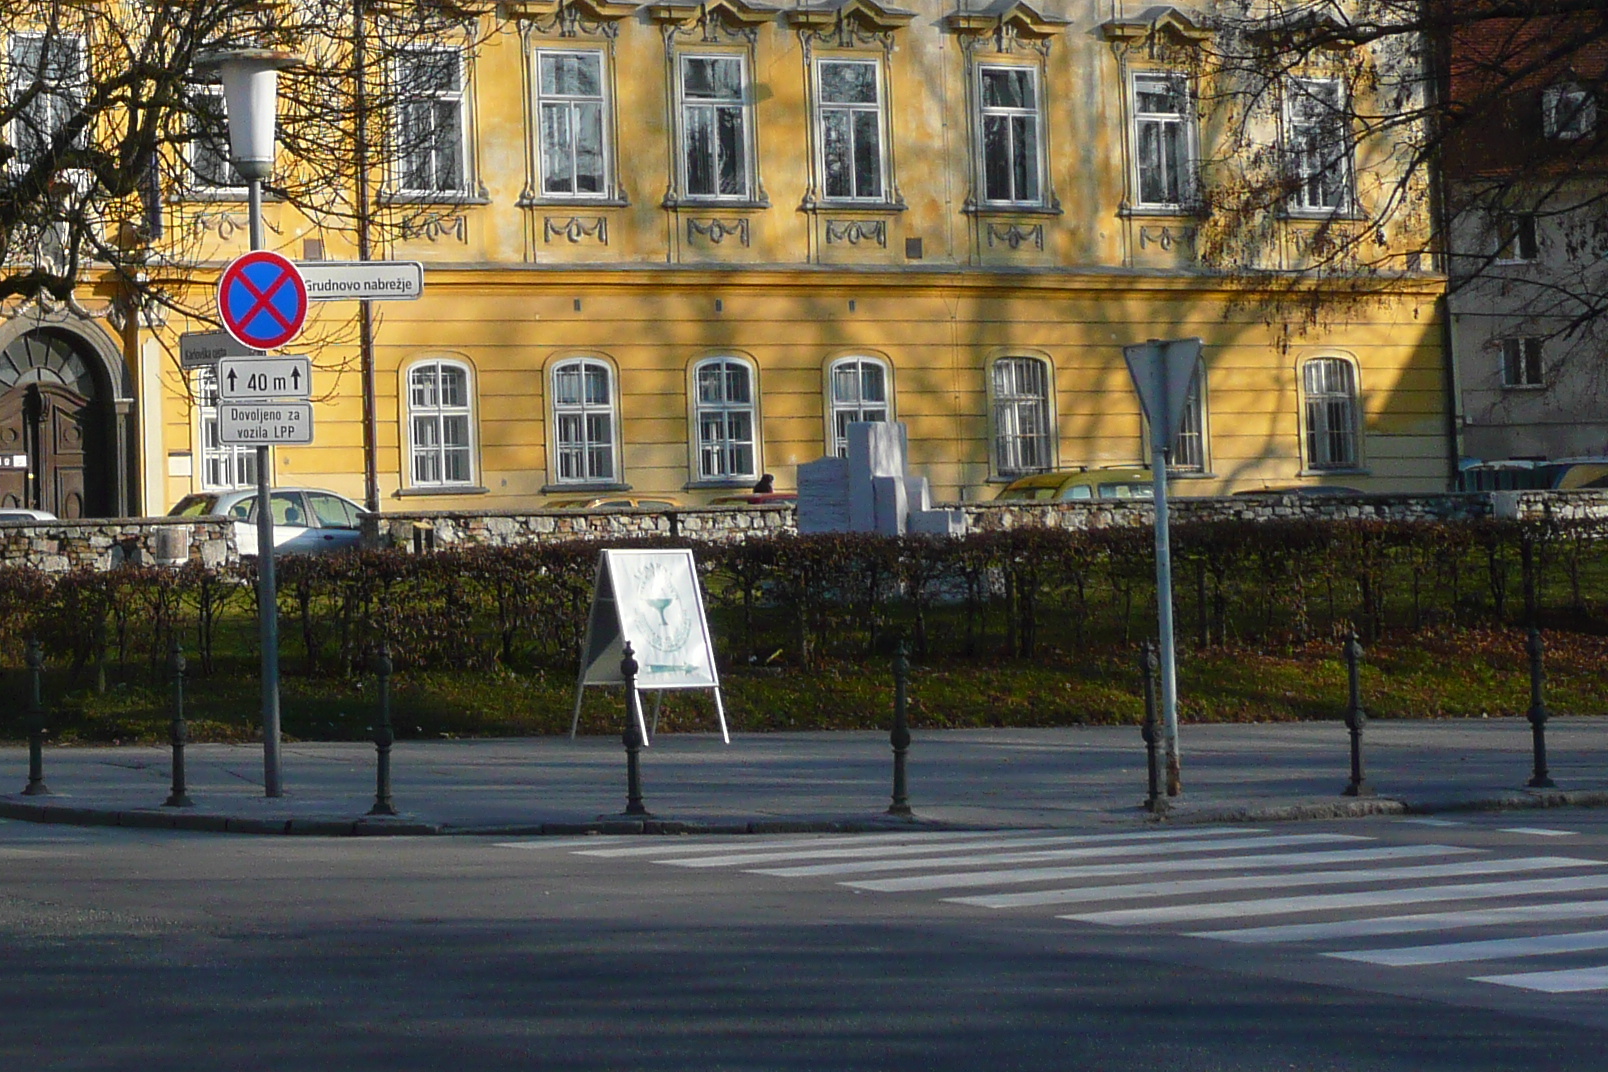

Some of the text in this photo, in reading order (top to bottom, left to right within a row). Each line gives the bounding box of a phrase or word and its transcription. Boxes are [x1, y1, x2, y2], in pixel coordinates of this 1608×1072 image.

[304, 278, 412, 293] Grudnovo nabrežje
[247, 373, 286, 391] 40 m
[231, 408, 300, 424] Dovoljeno za
[237, 425, 295, 439] vozila LPP
